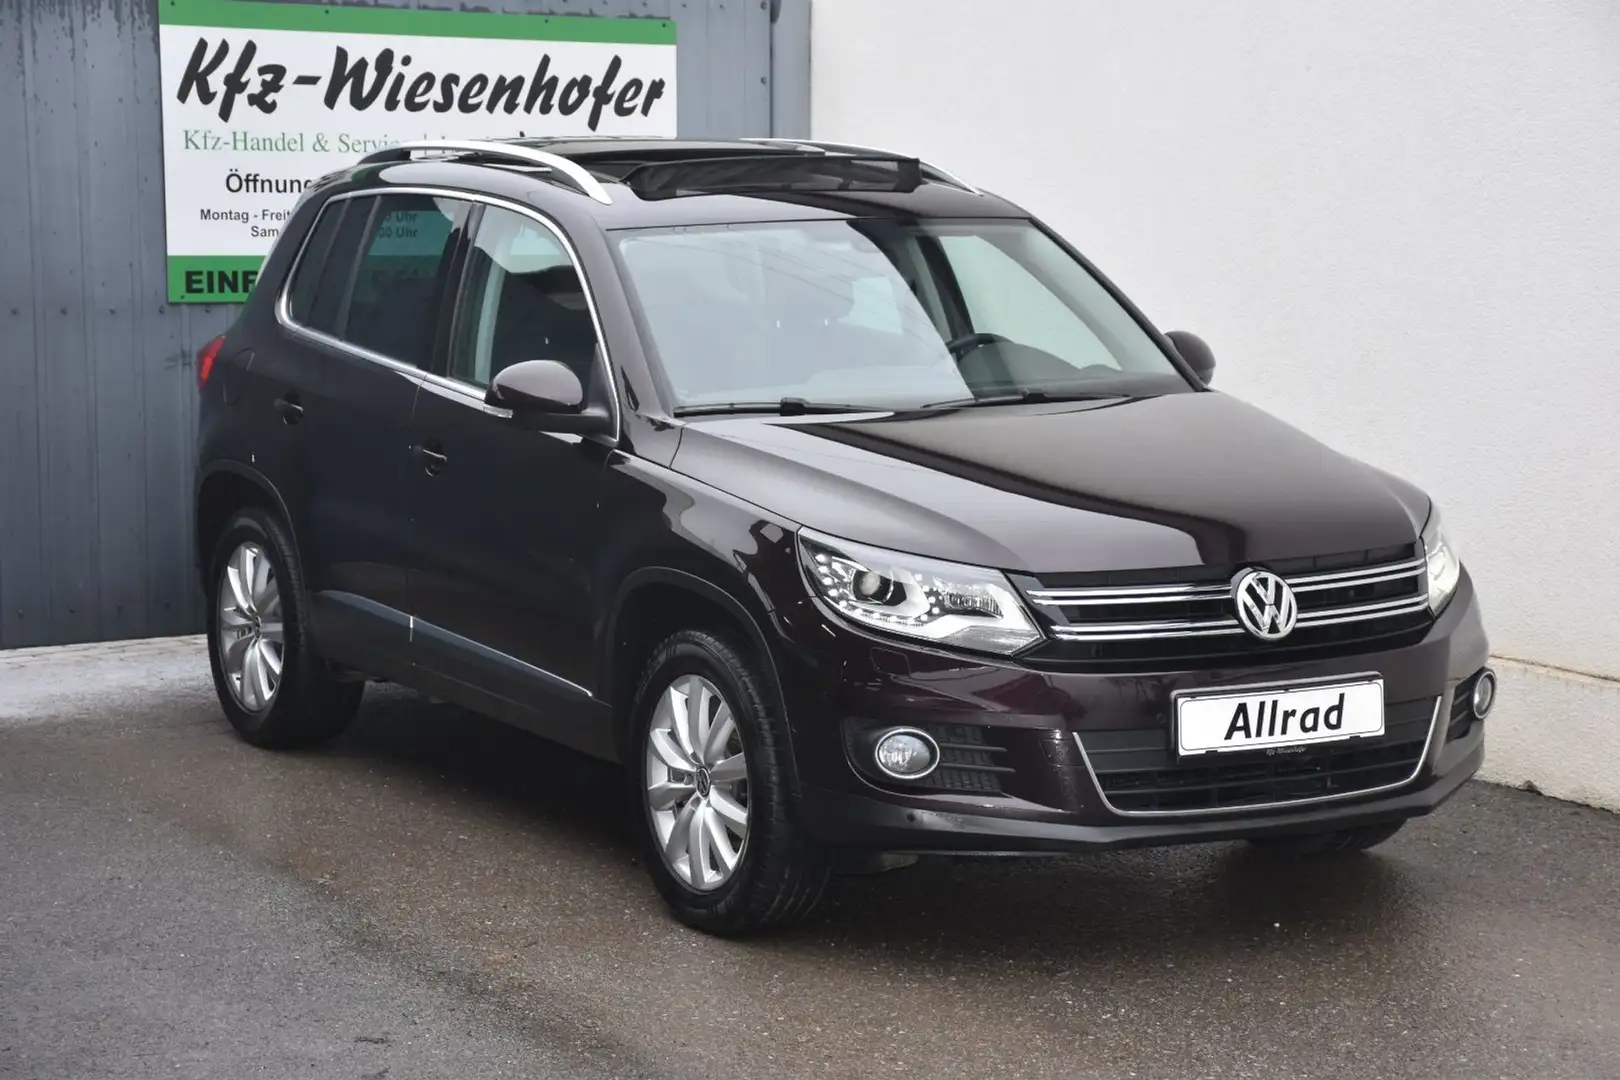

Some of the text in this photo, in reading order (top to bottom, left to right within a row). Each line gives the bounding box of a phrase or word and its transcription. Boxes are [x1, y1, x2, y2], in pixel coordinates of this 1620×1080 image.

[176, 37, 666, 132] Kfz-Wiesenhofer
[183, 129, 304, 152] Kfz-Handel
[312, 132, 331, 153] &
[338, 132, 400, 153] Servi
[200, 209, 249, 223] Montag
[251, 225, 279, 237] Sam
[185, 270, 258, 294] EINF
[1224, 692, 1345, 740] Allrad
